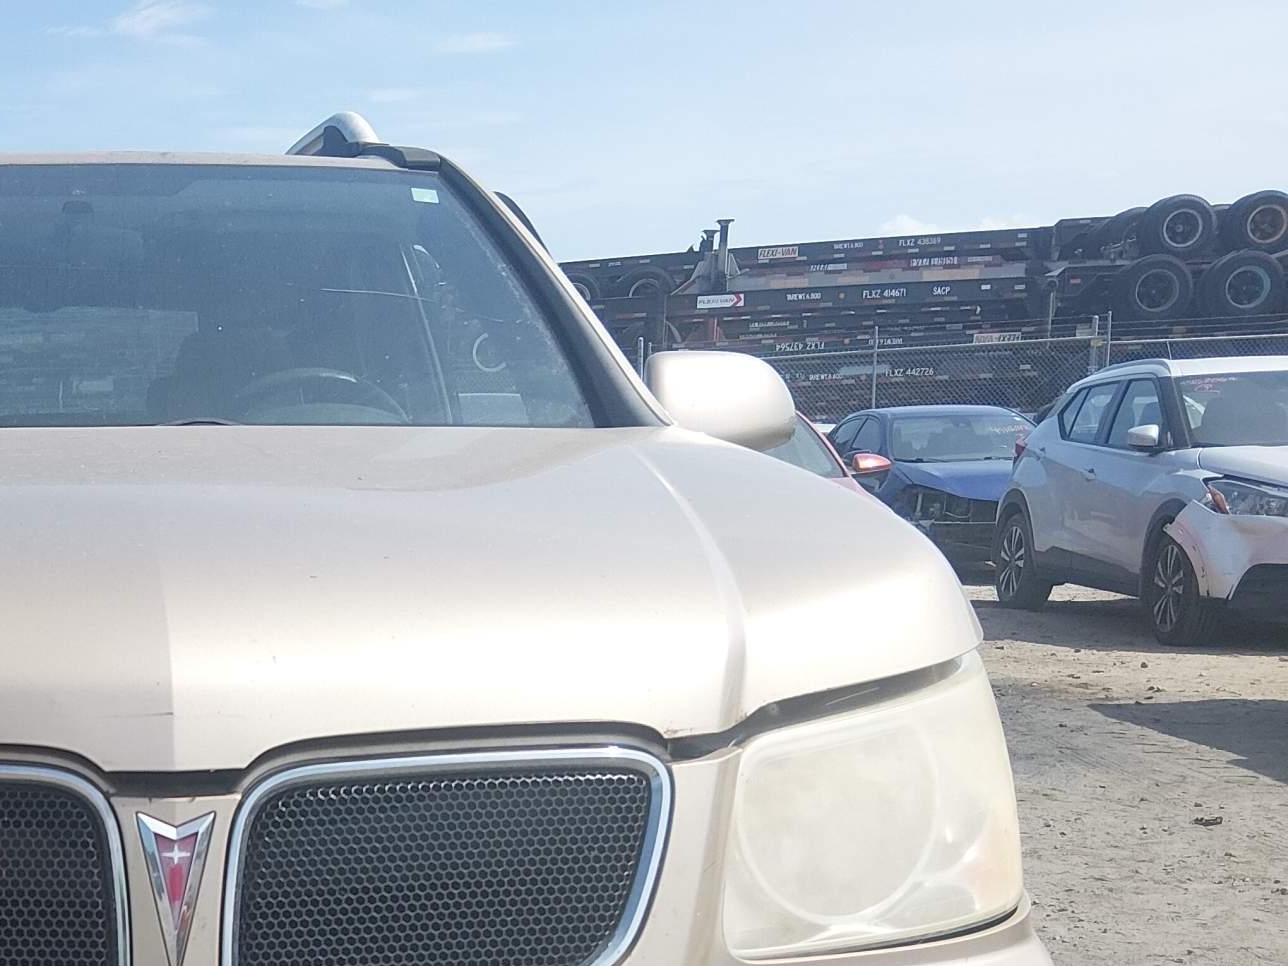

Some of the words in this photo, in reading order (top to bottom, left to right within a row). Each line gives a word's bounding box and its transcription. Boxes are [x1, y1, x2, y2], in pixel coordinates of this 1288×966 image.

[759, 247, 797, 258] FLEXI-VAN
[862, 289, 881, 299] FLXZ
[883, 288, 907, 297] 414671
[933, 286, 951, 295] SACP
[905, 367, 934, 376] 442726
